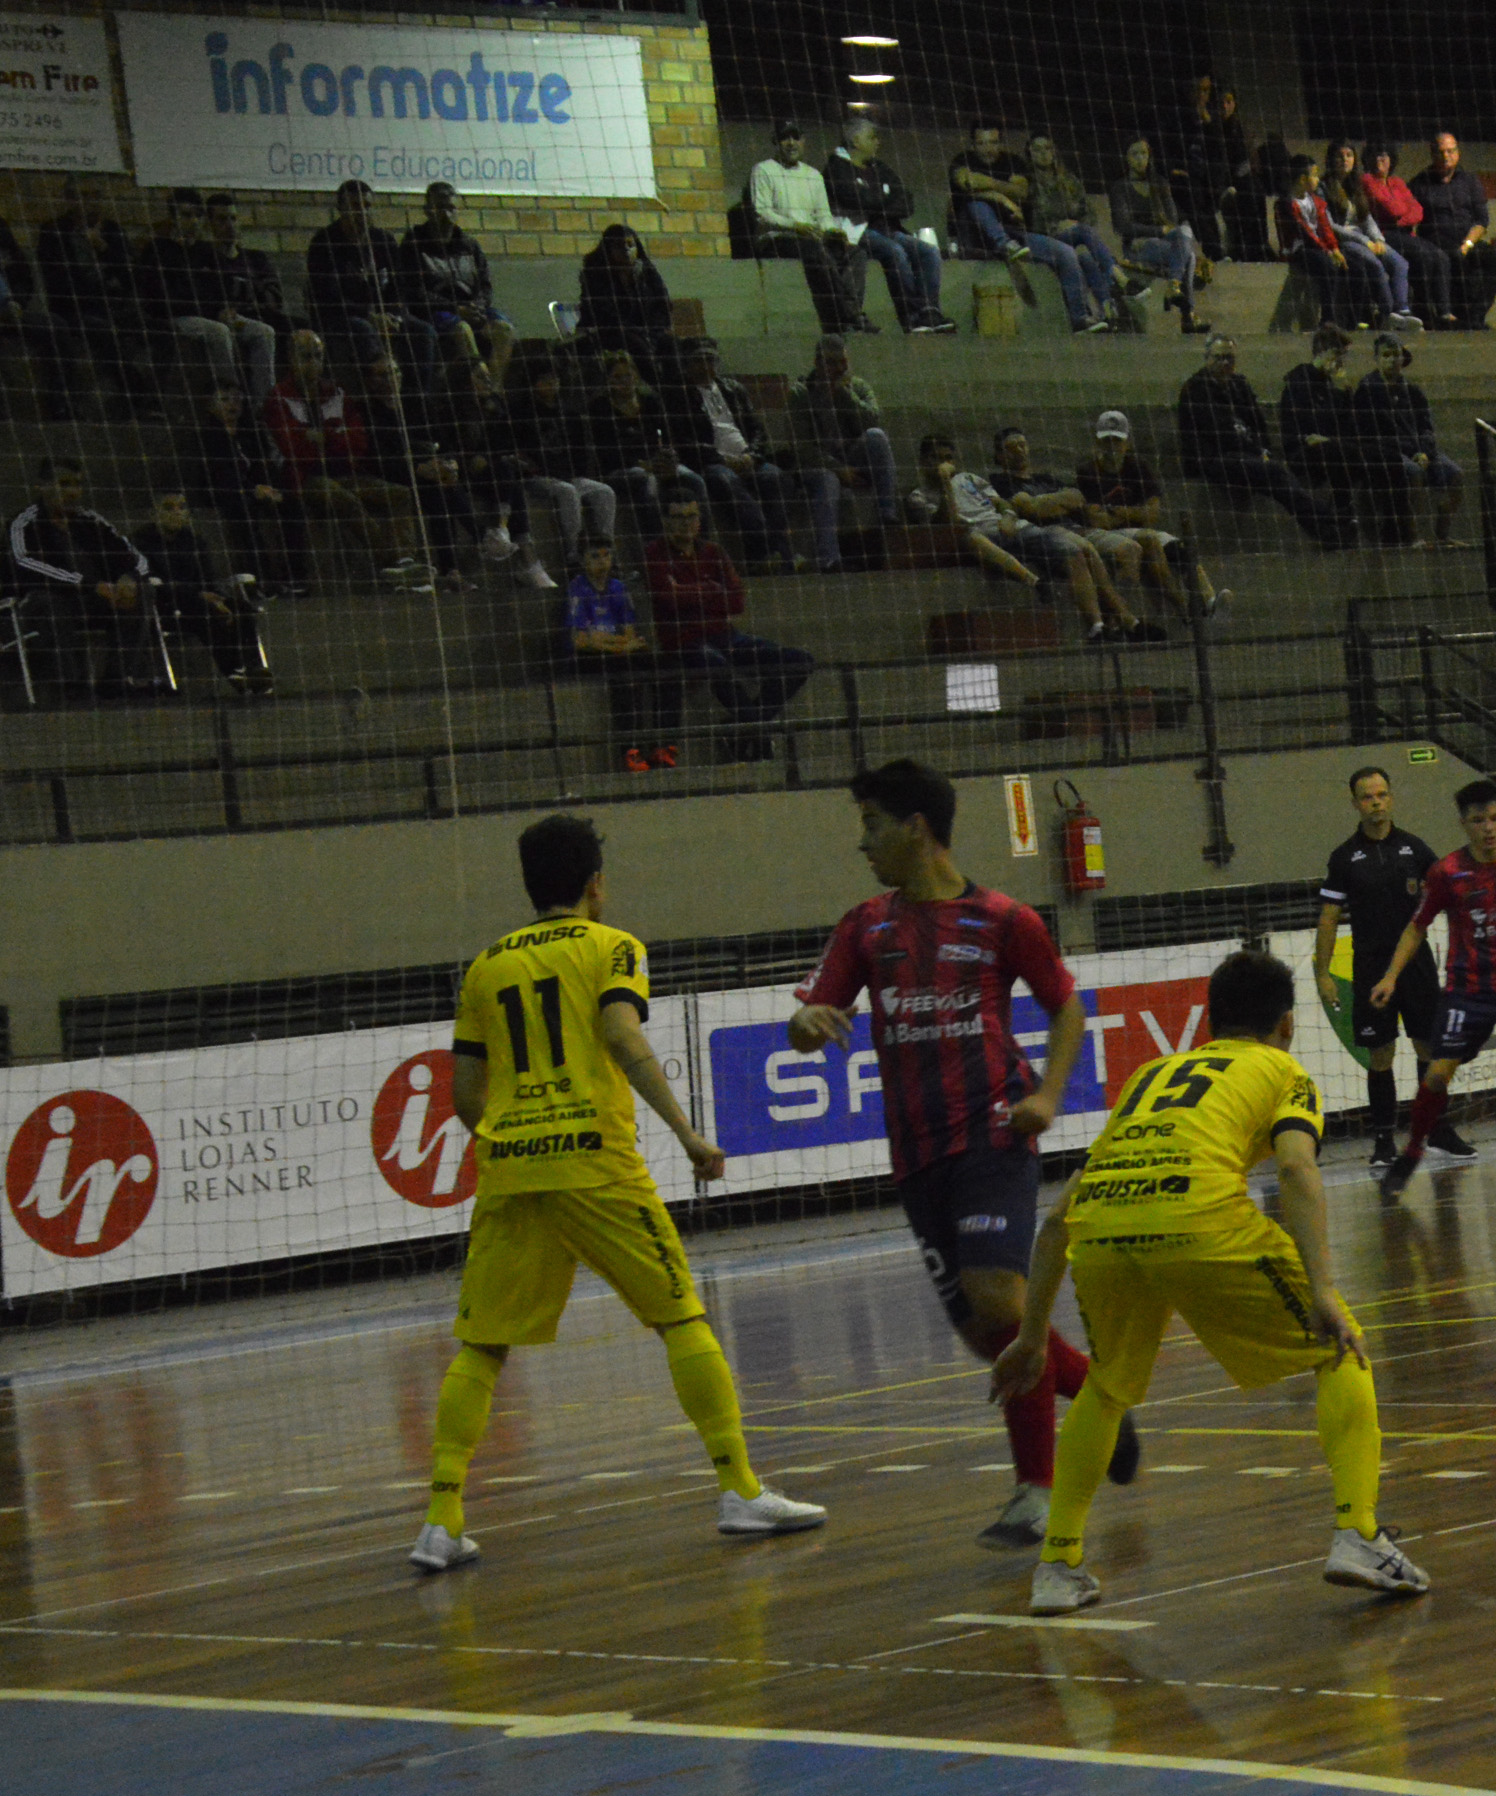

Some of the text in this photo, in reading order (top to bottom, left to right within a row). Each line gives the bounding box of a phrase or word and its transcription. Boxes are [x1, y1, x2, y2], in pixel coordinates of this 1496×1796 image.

[204, 30, 572, 124] informatize
[267, 142, 538, 182] Centro Educacional
[505, 925, 588, 950] UNISC
[496, 975, 566, 1074] 11
[896, 1012, 984, 1043] Banrisul
[1117, 1056, 1234, 1118] 15
[179, 1097, 360, 1142] INSTITUTO
[181, 1137, 278, 1172] LOJAS
[184, 1164, 314, 1204] RENNER
